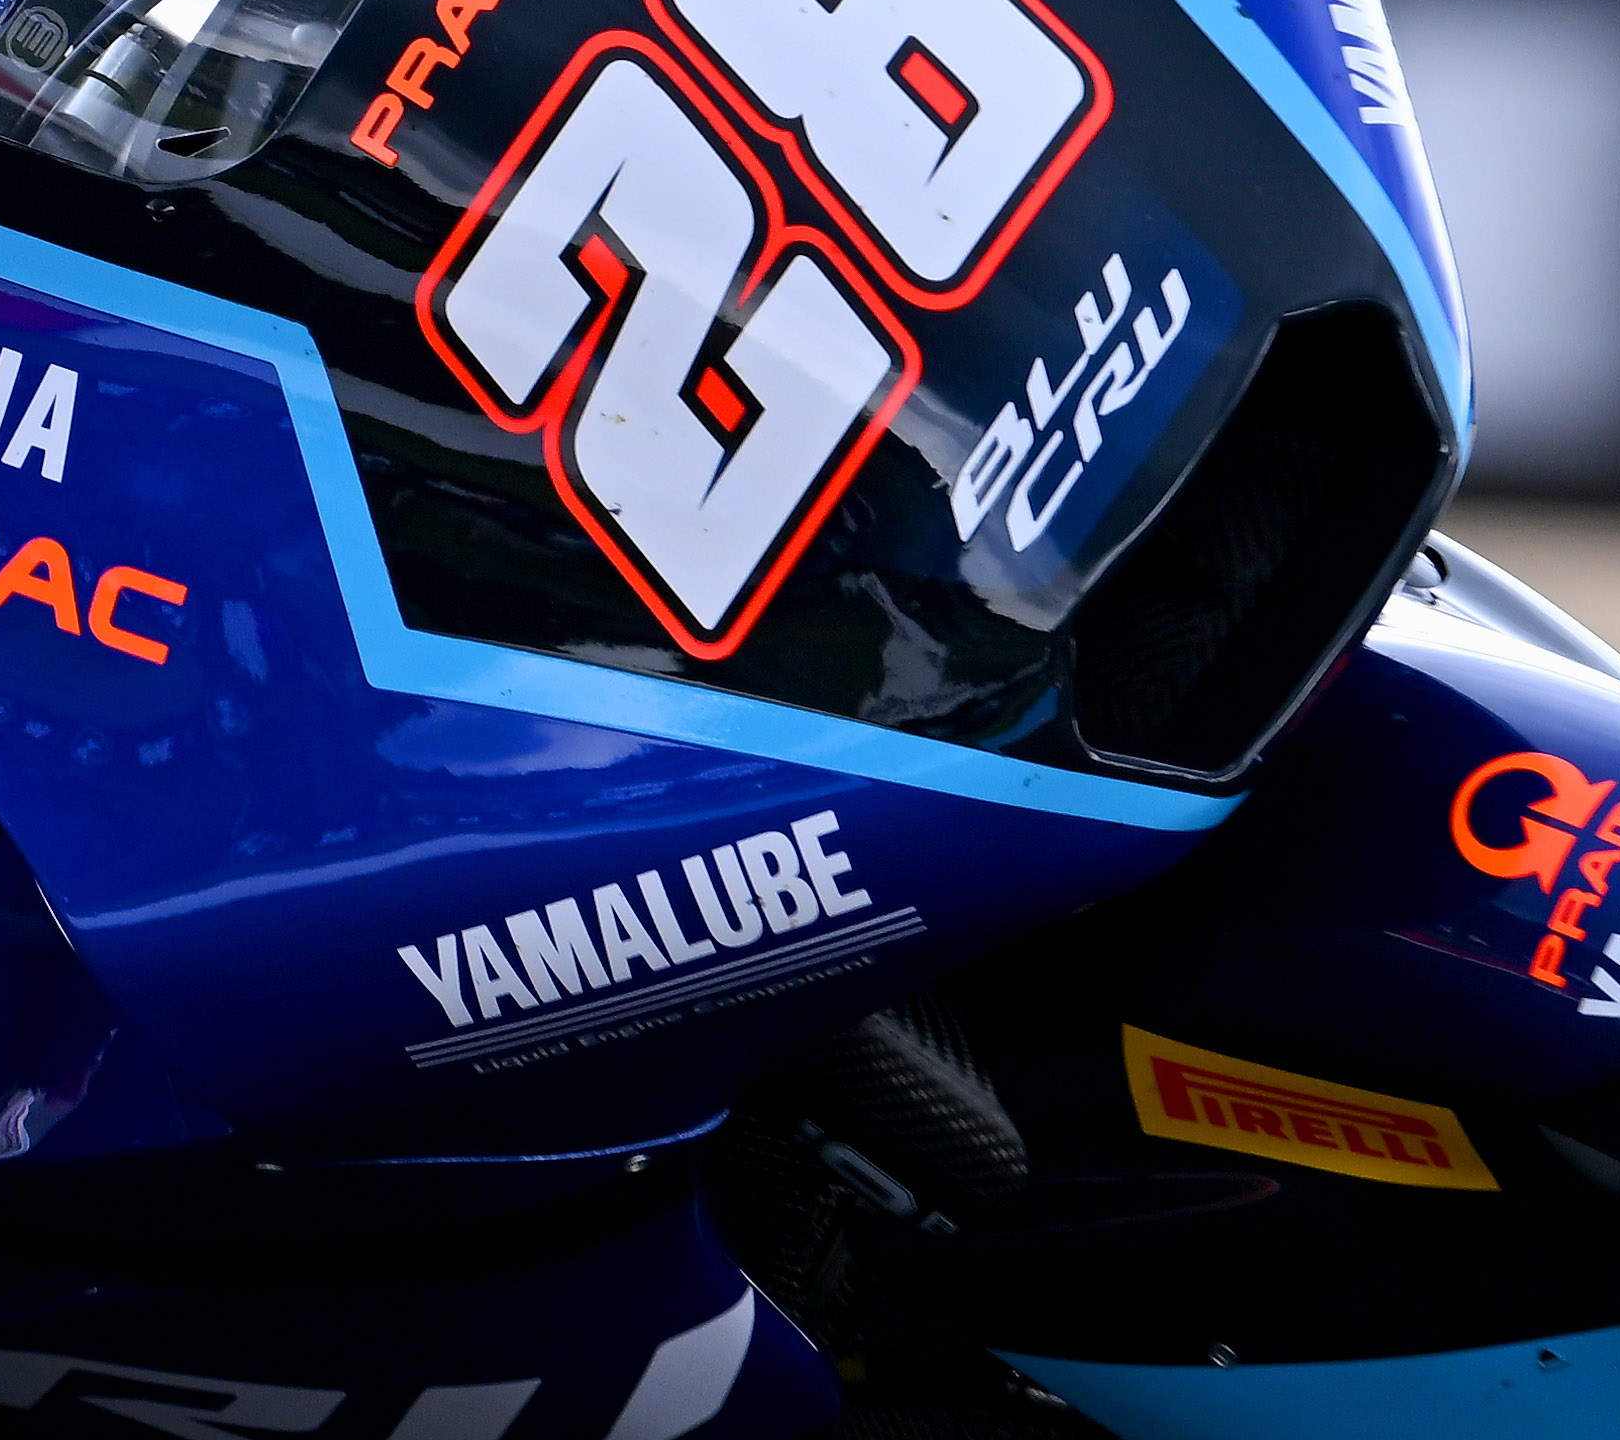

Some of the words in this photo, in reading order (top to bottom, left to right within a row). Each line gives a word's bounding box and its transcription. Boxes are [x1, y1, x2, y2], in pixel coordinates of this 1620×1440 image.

[952, 253, 1133, 542] BLU
[1007, 269, 1192, 553] CRU
[396, 810, 873, 1028] YAMALUBE
[577, 1013, 684, 1050] Engine
[692, 955, 875, 1015] Component
[1150, 1054, 1454, 1171] PIRELLI
